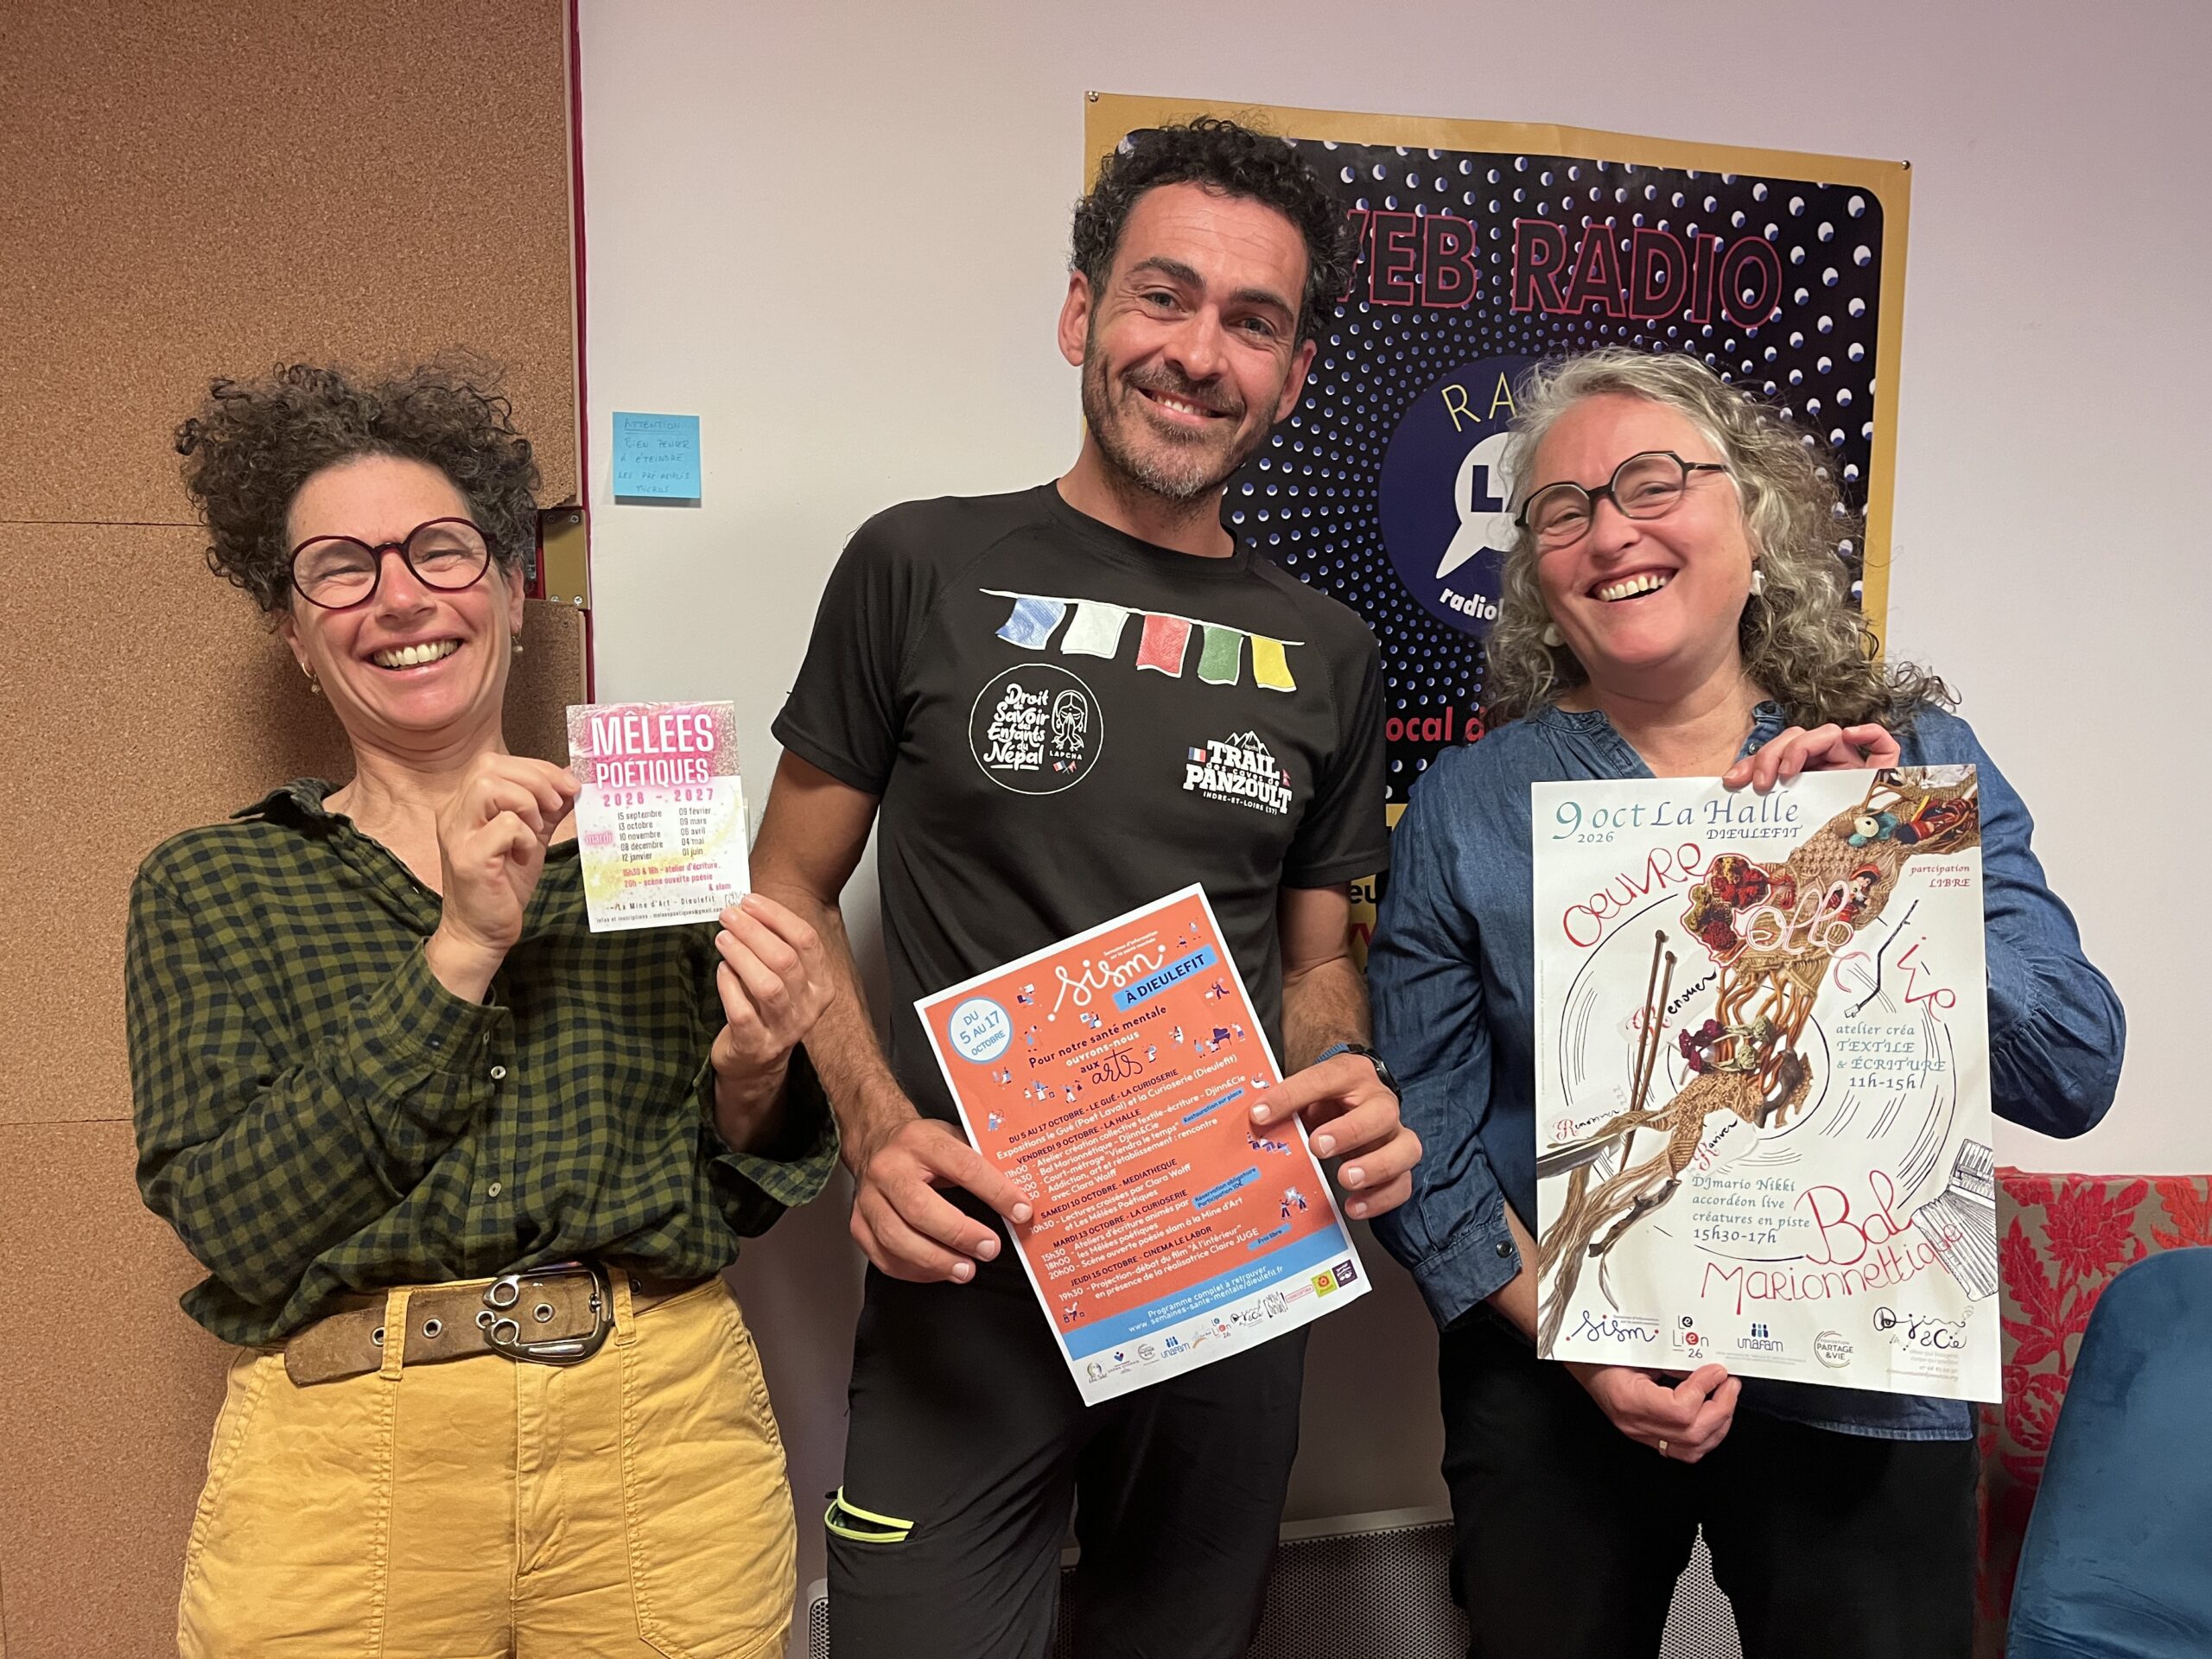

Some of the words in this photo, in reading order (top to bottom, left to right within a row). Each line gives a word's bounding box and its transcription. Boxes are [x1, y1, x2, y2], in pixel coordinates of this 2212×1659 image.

[1512, 219, 1783, 328] RADIO
[1441, 371, 1516, 432] RA
[625, 418, 681, 429] ATTENTION
[1440, 588, 1503, 621] radio
[1005, 683, 1049, 705] Droit
[994, 701, 1050, 725] Savoir
[1385, 706, 1453, 741] ocal
[590, 710, 715, 756] MÊLÉES
[987, 721, 1046, 747] Enfants
[1018, 721, 1031, 730] des
[983, 741, 1044, 771] Népal
[1017, 741, 1028, 752] du
[1050, 750, 1083, 760] LAPCHA
[1207, 740, 1281, 779] TRAIL
[596, 758, 709, 789] POÉTIQUES
[1206, 762, 1226, 772] des
[1232, 768, 1263, 782] caves
[674, 788, 714, 802] 2027
[1183, 763, 1293, 814] PANZOULT
[626, 810, 662, 821] septembre
[689, 806, 711, 815] février
[1203, 791, 1264, 810] INDRE-ET-LOIRE
[1265, 806, 1278, 816] (37)
[1650, 802, 1694, 827] La
[1704, 791, 1799, 824] Halle
[626, 821, 653, 830] octobre
[690, 827, 705, 836] avril
[1553, 802, 1582, 840] 9
[1592, 804, 1646, 828] oct
[1707, 825, 1803, 840] DIEULEFIT
[586, 831, 613, 845] mardi
[627, 831, 661, 841] novembre
[631, 841, 664, 850] décembre
[1577, 832, 1615, 843] 2026
[630, 852, 652, 863] janvier
[690, 847, 703, 857] juin
[1929, 878, 1970, 887] LIBRE
[681, 896, 715, 906] Dieulefit
[1122, 988, 1136, 1004] À
[1134, 953, 1208, 997] DIEULEFIT
[958, 1029, 972, 1045] 5
[970, 1022, 988, 1039] AU
[983, 1009, 1002, 1028] 17
[962, 1010, 980, 1027] DU
[1835, 1022, 1881, 1035] atelier
[1886, 1023, 1915, 1035] créa
[969, 1030, 1007, 1056] OCTOBRE
[1027, 1049, 1056, 1069] Pour
[1057, 1036, 1088, 1057] notre
[1087, 1022, 1120, 1044] santé
[1119, 1001, 1167, 1030] mentale
[1836, 1041, 1915, 1052] TEXTILE
[1065, 1030, 1141, 1067] ouvrons-nous
[1079, 1059, 1101, 1074] aux
[1090, 1046, 1143, 1086] arts
[1852, 1058, 1946, 1071] ÉCRITURE
[1849, 1072, 1916, 1090] 11h-15h
[995, 1133, 1046, 1160] Expositions
[1147, 1071, 1193, 1098] Curioserie
[1192, 1053, 1237, 1078] (Dieulefit)
[1047, 1107, 1084, 1128] OCTOBRE
[1132, 1068, 1179, 1092] CURIOSERIE
[1035, 1150, 1064, 1167] Atelier
[1063, 1135, 1099, 1156] création
[1097, 1119, 1137, 1141] collective
[1137, 1094, 1199, 1125] textile-écriture
[1204, 1073, 1246, 1098] Djinn&Cie
[1177, 1117, 1217, 1139] rencontre
[1016, 1144, 1055, 1165] VENDREDI
[1061, 1125, 1099, 1146] OCTOBRE
[1115, 1108, 1141, 1123] HALLE
[1039, 1164, 1054, 1176] Bal
[1053, 1139, 1113, 1171] Marionnétique
[1042, 1153, 1105, 1186] Court-métrage
[1040, 1202, 1070, 1219] SAMEDI
[1080, 1183, 1117, 1203] OCTOBRE
[1122, 1158, 1177, 1186] MEDIATHEQUE
[1050, 1189, 1071, 1202] avec
[1070, 1178, 1095, 1193] Clara
[1093, 1168, 1117, 1184] Wolff
[1757, 1179, 1796, 1192] Nikki
[1059, 1203, 1096, 1224] Lectures
[1094, 1189, 1128, 1209] croisées
[1692, 1194, 1757, 1208] accordéon
[1761, 1195, 1785, 1209] live
[1052, 1233, 1078, 1249] MARDI
[1141, 1189, 1187, 1213] CURIOSERIE
[1693, 1211, 1753, 1224] créatures
[1758, 1217, 1773, 1225] en
[1777, 1216, 1810, 1230] piste
[1794, 1170, 1914, 1266] Bal
[1209, 1237, 1235, 1254] Claire
[1234, 1227, 1259, 1243] JUGE
[1694, 1229, 1778, 1244] 15h30-17h
[1070, 1273, 1091, 1287] JEUDI
[1142, 1241, 1173, 1259] CINEMA
[1185, 1225, 1211, 1242] LABOR
[1058, 1286, 1084, 1302] 19h30
[1090, 1256, 1160, 1293] Projection-débat
[1147, 1294, 1193, 1319] Programme
[1672, 1329, 1710, 1348] Lien
[1816, 1343, 1853, 1354] PARTAGE
[1688, 1348, 1703, 1359] 26
[1826, 1351, 1846, 1361] &VIE
